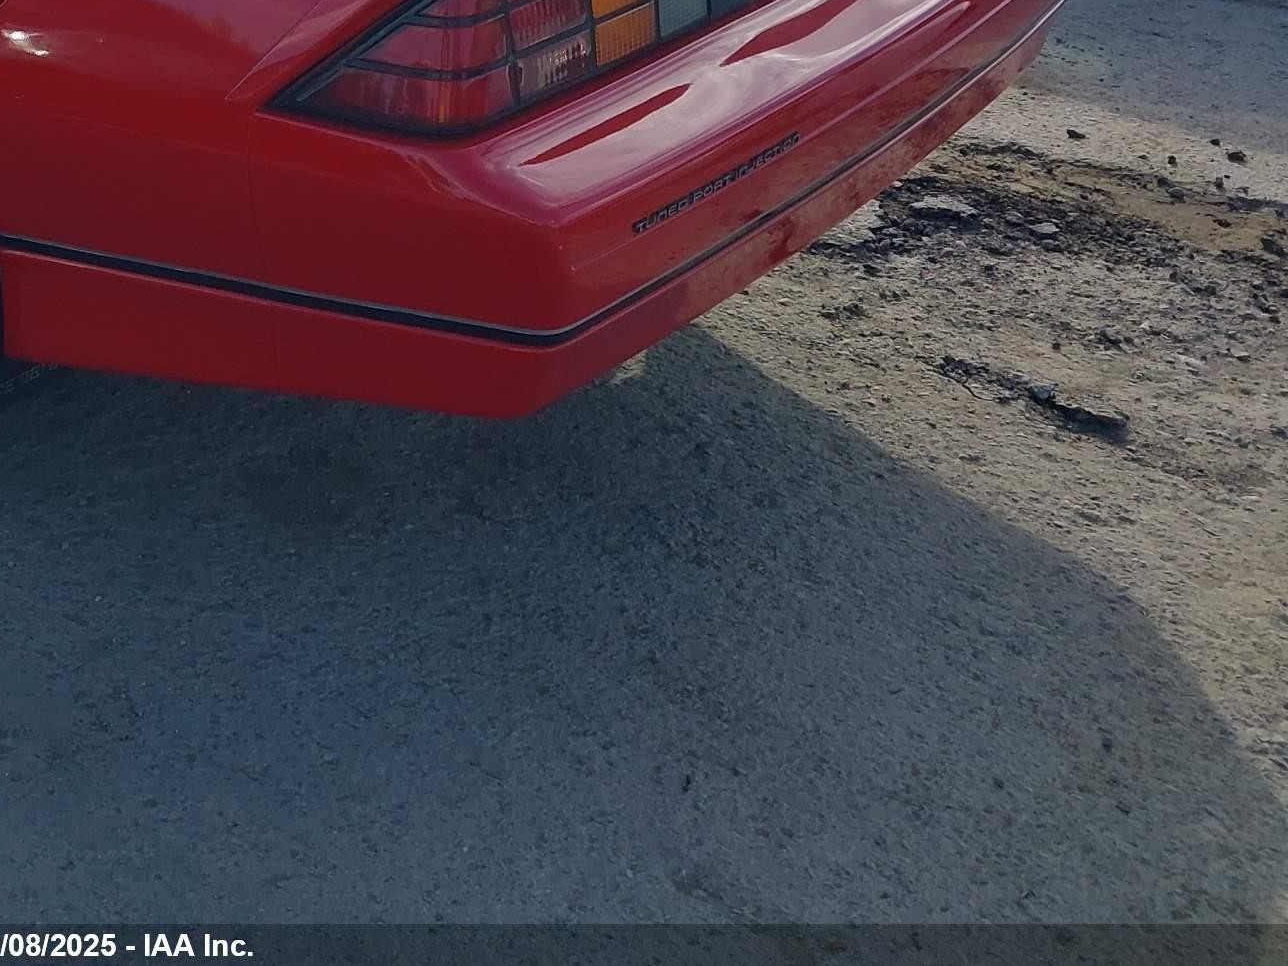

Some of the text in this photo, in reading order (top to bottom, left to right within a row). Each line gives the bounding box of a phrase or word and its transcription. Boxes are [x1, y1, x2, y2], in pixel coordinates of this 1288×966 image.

[635, 131, 801, 233] TUNED PORT INJECTION
